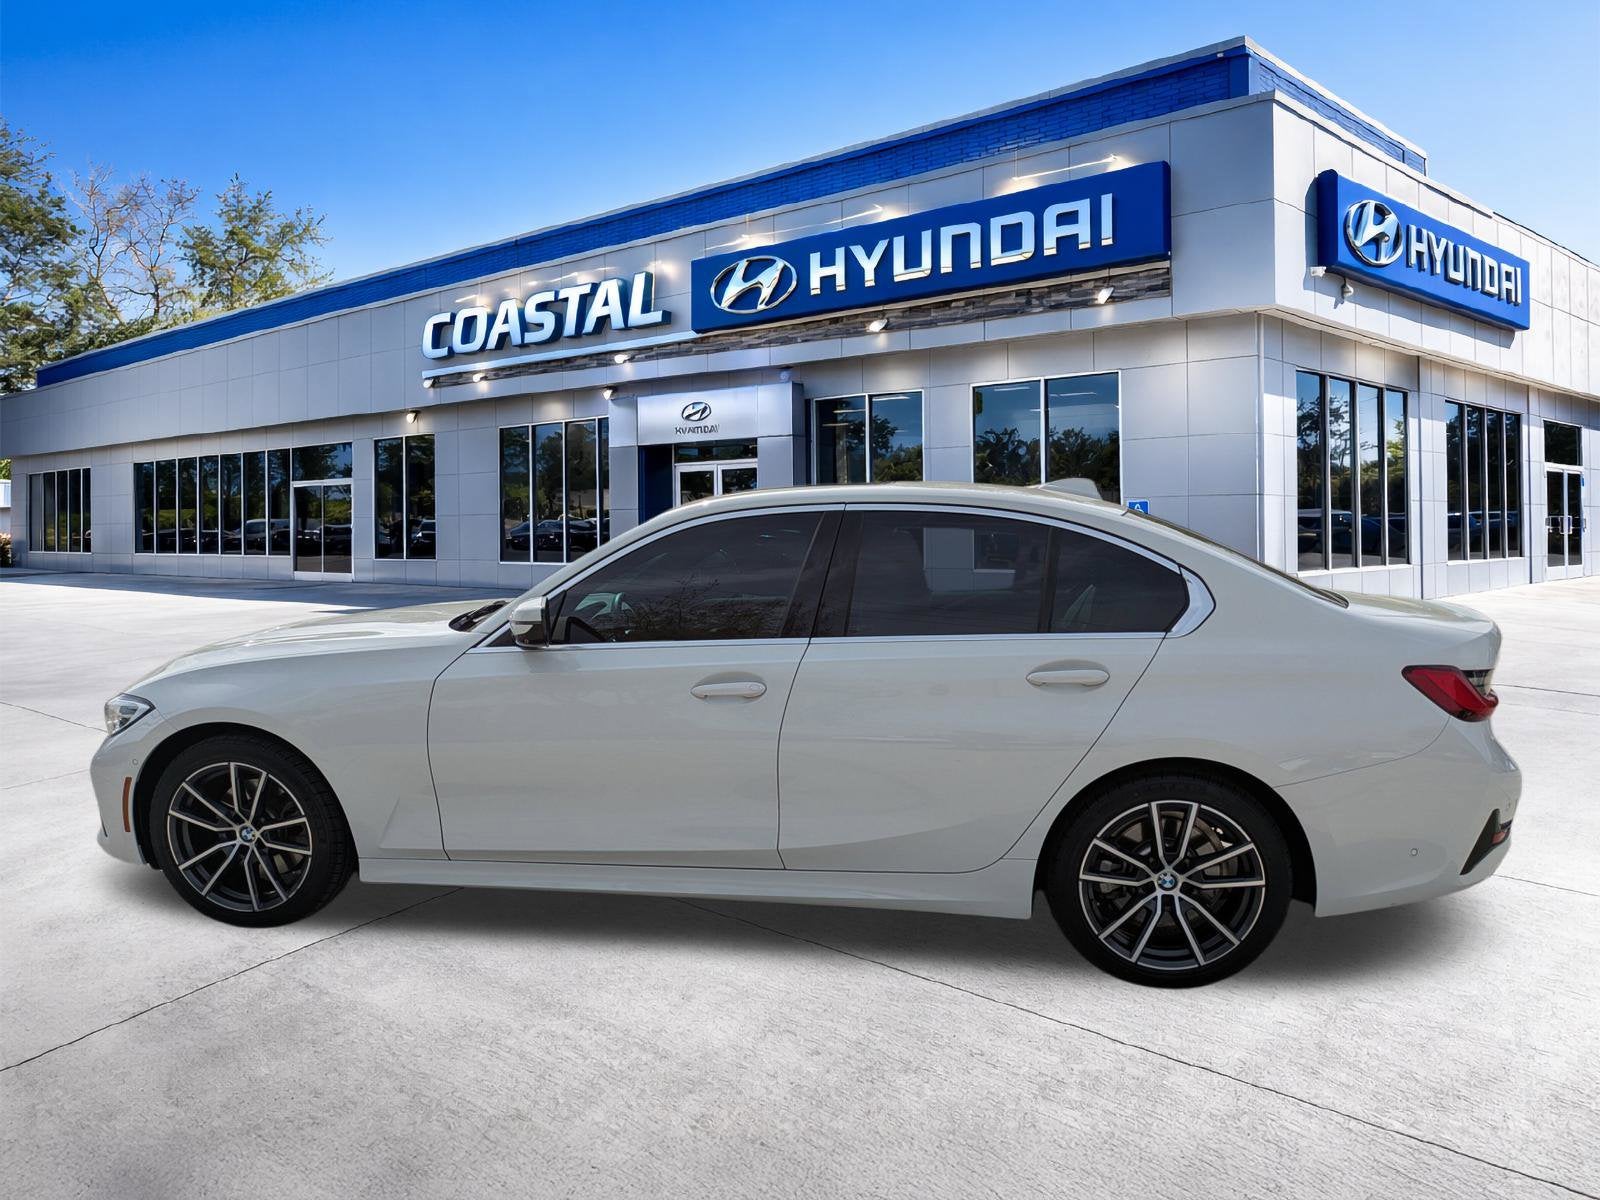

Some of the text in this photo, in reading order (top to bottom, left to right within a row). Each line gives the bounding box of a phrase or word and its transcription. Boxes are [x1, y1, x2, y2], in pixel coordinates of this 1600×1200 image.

[810, 193, 1113, 295] HYUNDAI
[1406, 224, 1521, 306] HYUNDAI
[422, 271, 671, 359] COASTAL
